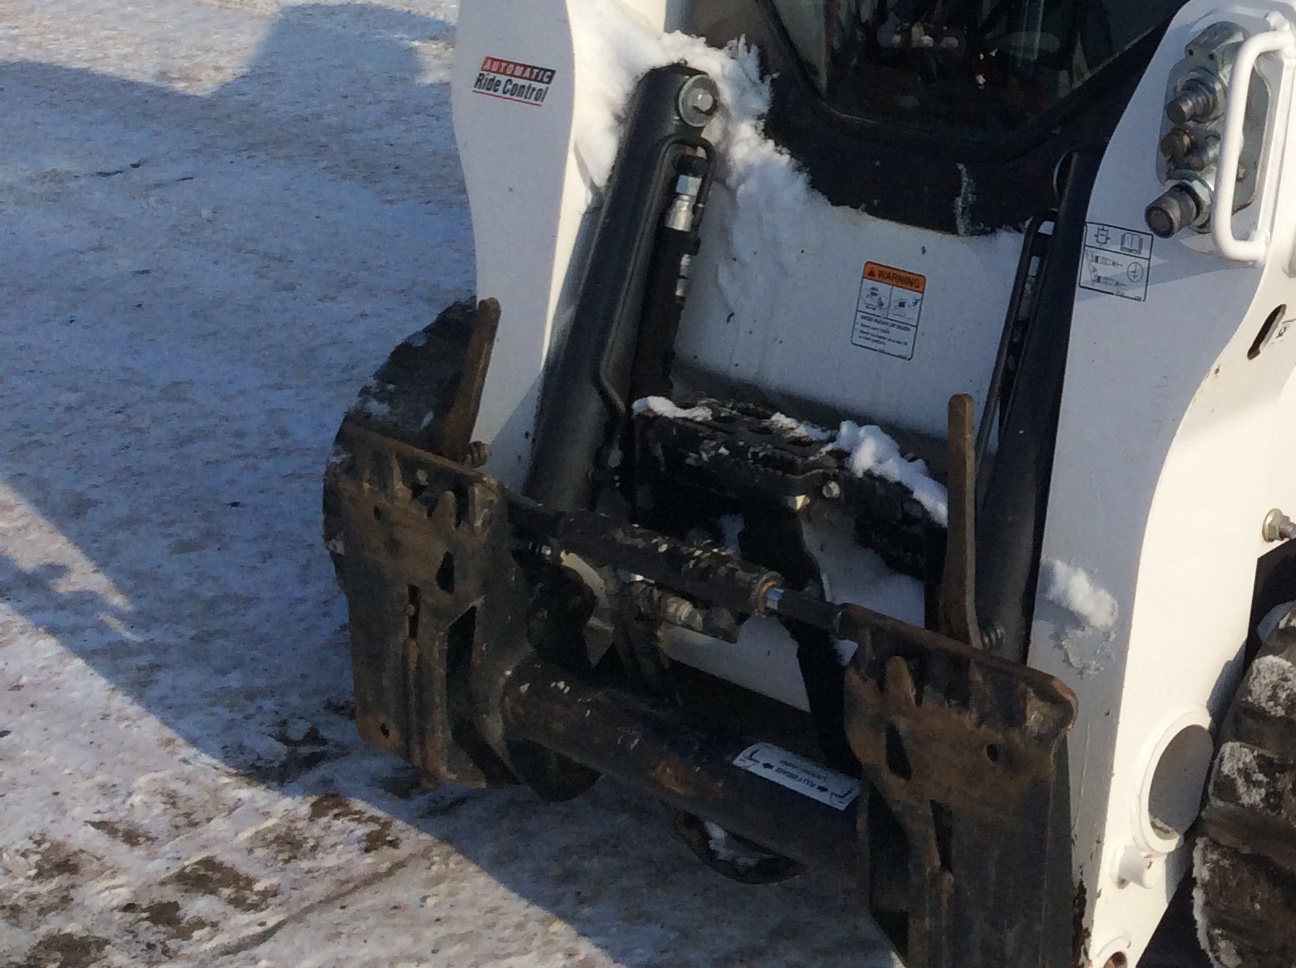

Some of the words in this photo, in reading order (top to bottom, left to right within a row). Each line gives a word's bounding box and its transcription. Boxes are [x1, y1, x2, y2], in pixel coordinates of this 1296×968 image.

[482, 58, 553, 83] AUTOMATIC
[473, 72, 502, 93] Ride
[501, 78, 550, 103] Control
[878, 269, 920, 289] WARNING
